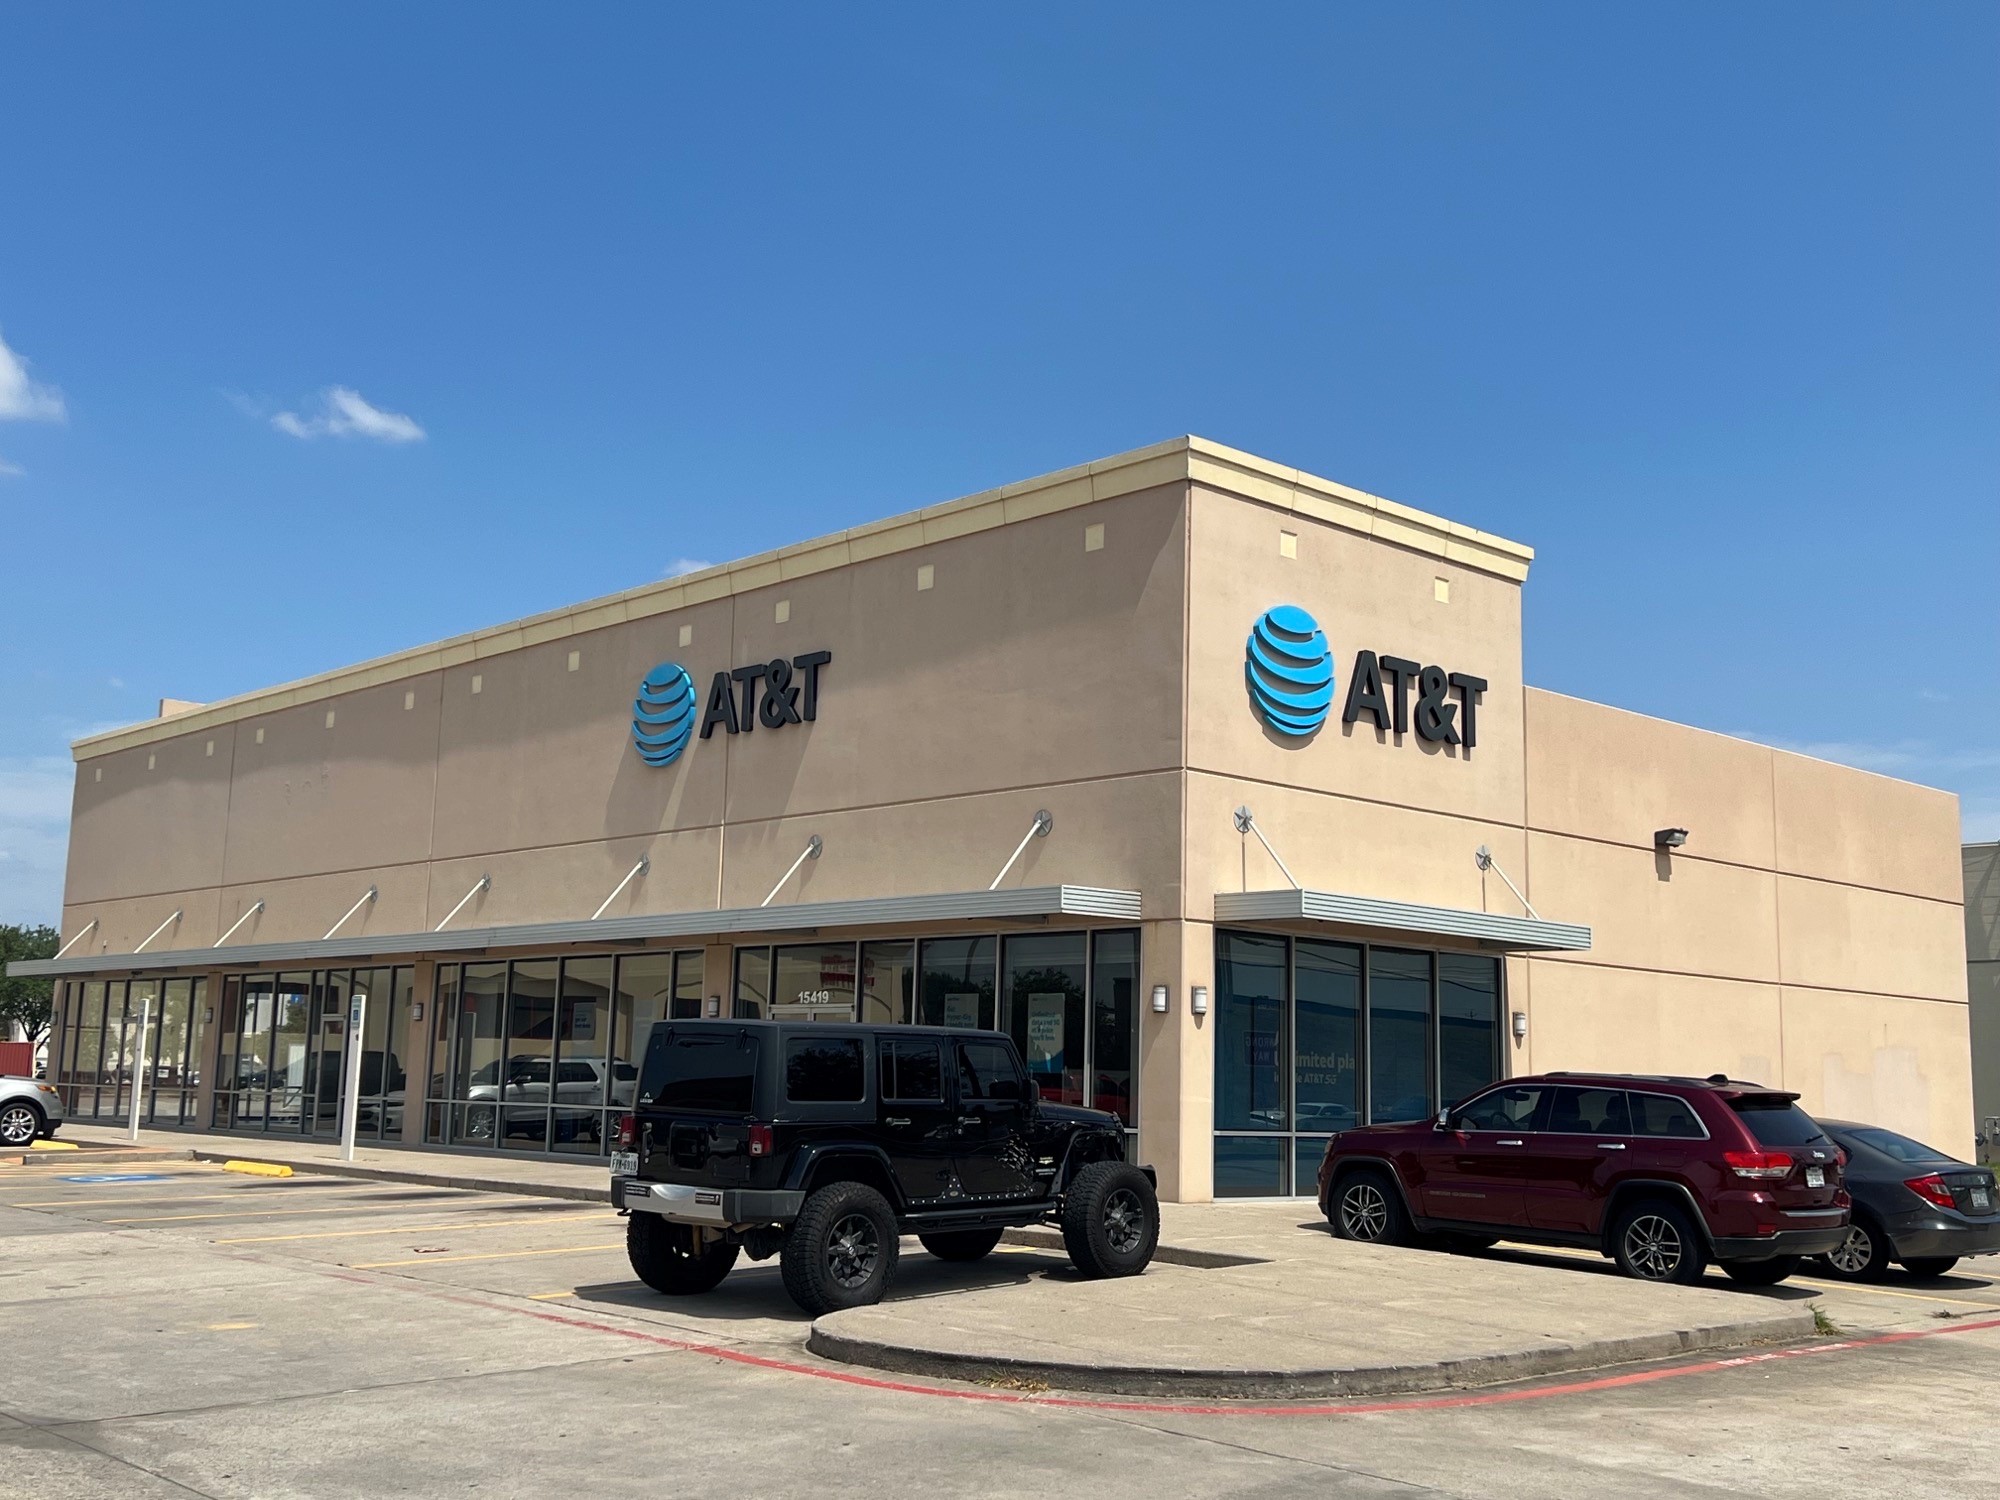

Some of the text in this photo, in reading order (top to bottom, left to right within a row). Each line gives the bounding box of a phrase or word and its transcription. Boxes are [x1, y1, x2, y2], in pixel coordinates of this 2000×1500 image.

[699, 650, 832, 739] AT&T
[1342, 649, 1488, 747] AT&T
[798, 990, 829, 1004] 15419
[1303, 1073, 1324, 1084] AT&T
